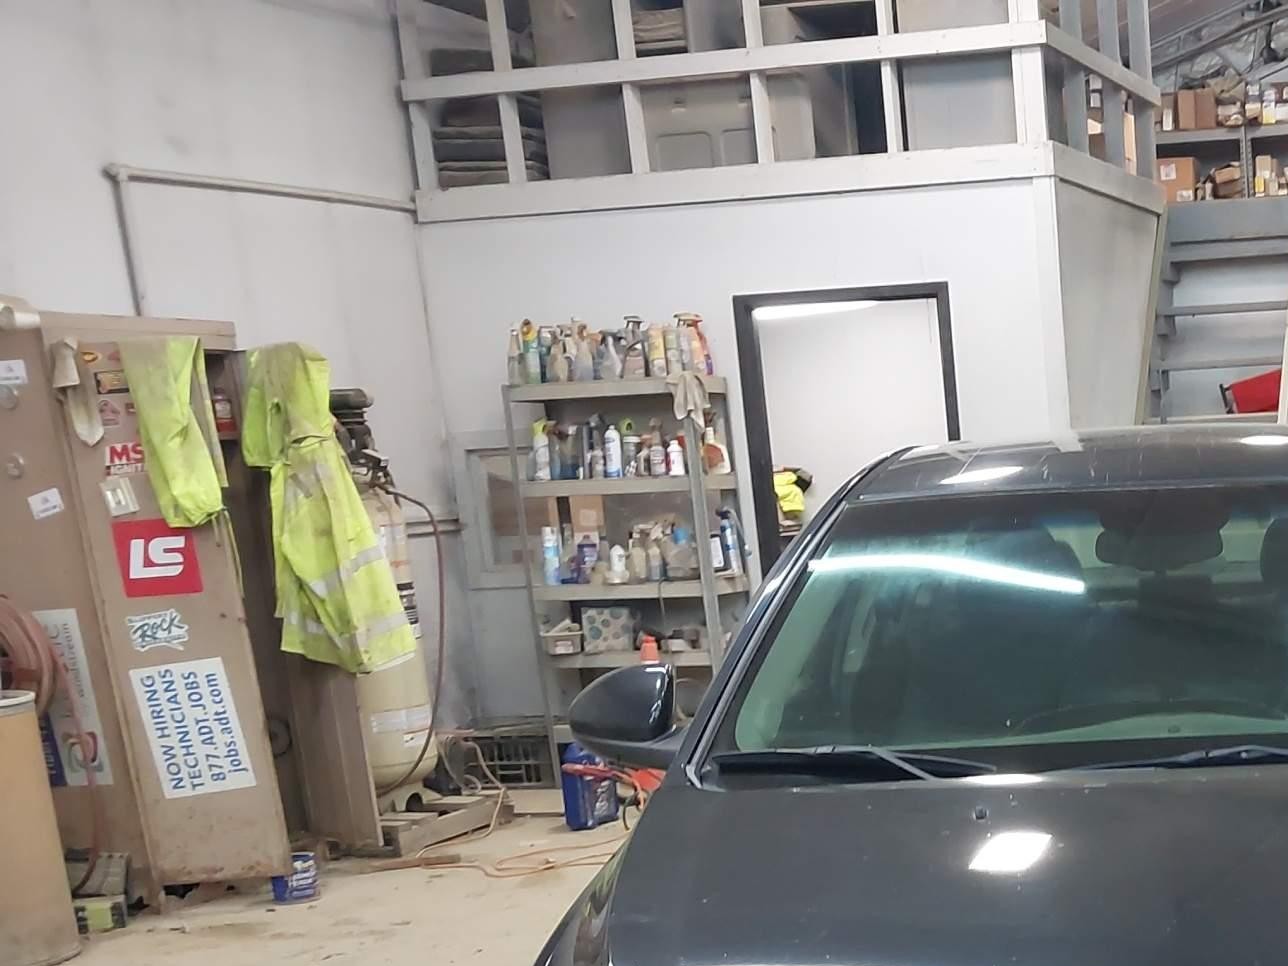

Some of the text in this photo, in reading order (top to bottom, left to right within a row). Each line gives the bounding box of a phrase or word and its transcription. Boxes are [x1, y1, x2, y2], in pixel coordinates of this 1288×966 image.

[140, 675, 171, 739] HIRING
[159, 669, 205, 790] TECHNICIANS
[181, 672, 227, 782] 877.ADT.JOBS
[205, 673, 249, 774] jobs.adt.com
[161, 745, 186, 790] NOW
